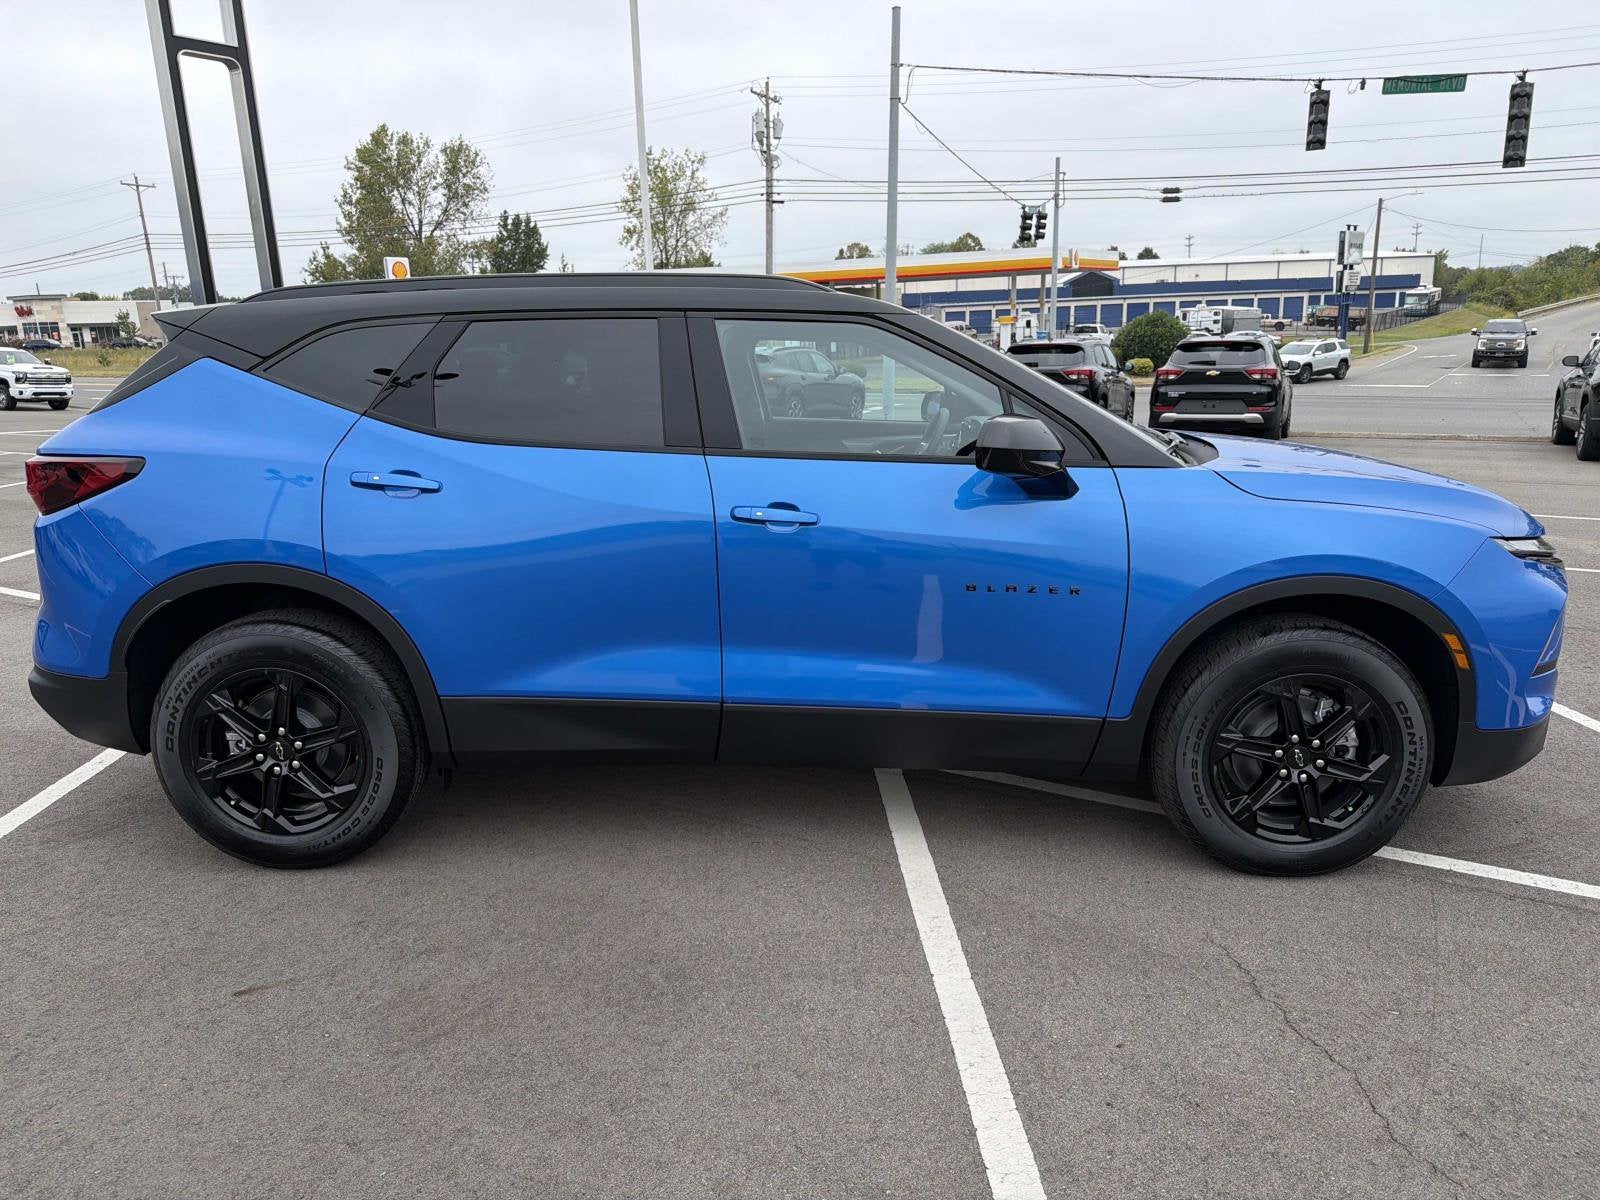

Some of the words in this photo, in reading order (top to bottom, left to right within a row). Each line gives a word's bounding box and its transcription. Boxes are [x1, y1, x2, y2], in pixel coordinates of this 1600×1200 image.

[1384, 78, 1433, 93] MEMORIAL
[1439, 76, 1465, 90] BLVD
[965, 583, 1081, 596] BLAZER
[165, 648, 264, 753] CONTINENT
[360, 756, 384, 816] CROSS
[1191, 758, 1213, 818] CROSS
[1367, 701, 1418, 840] CONTINENTA
